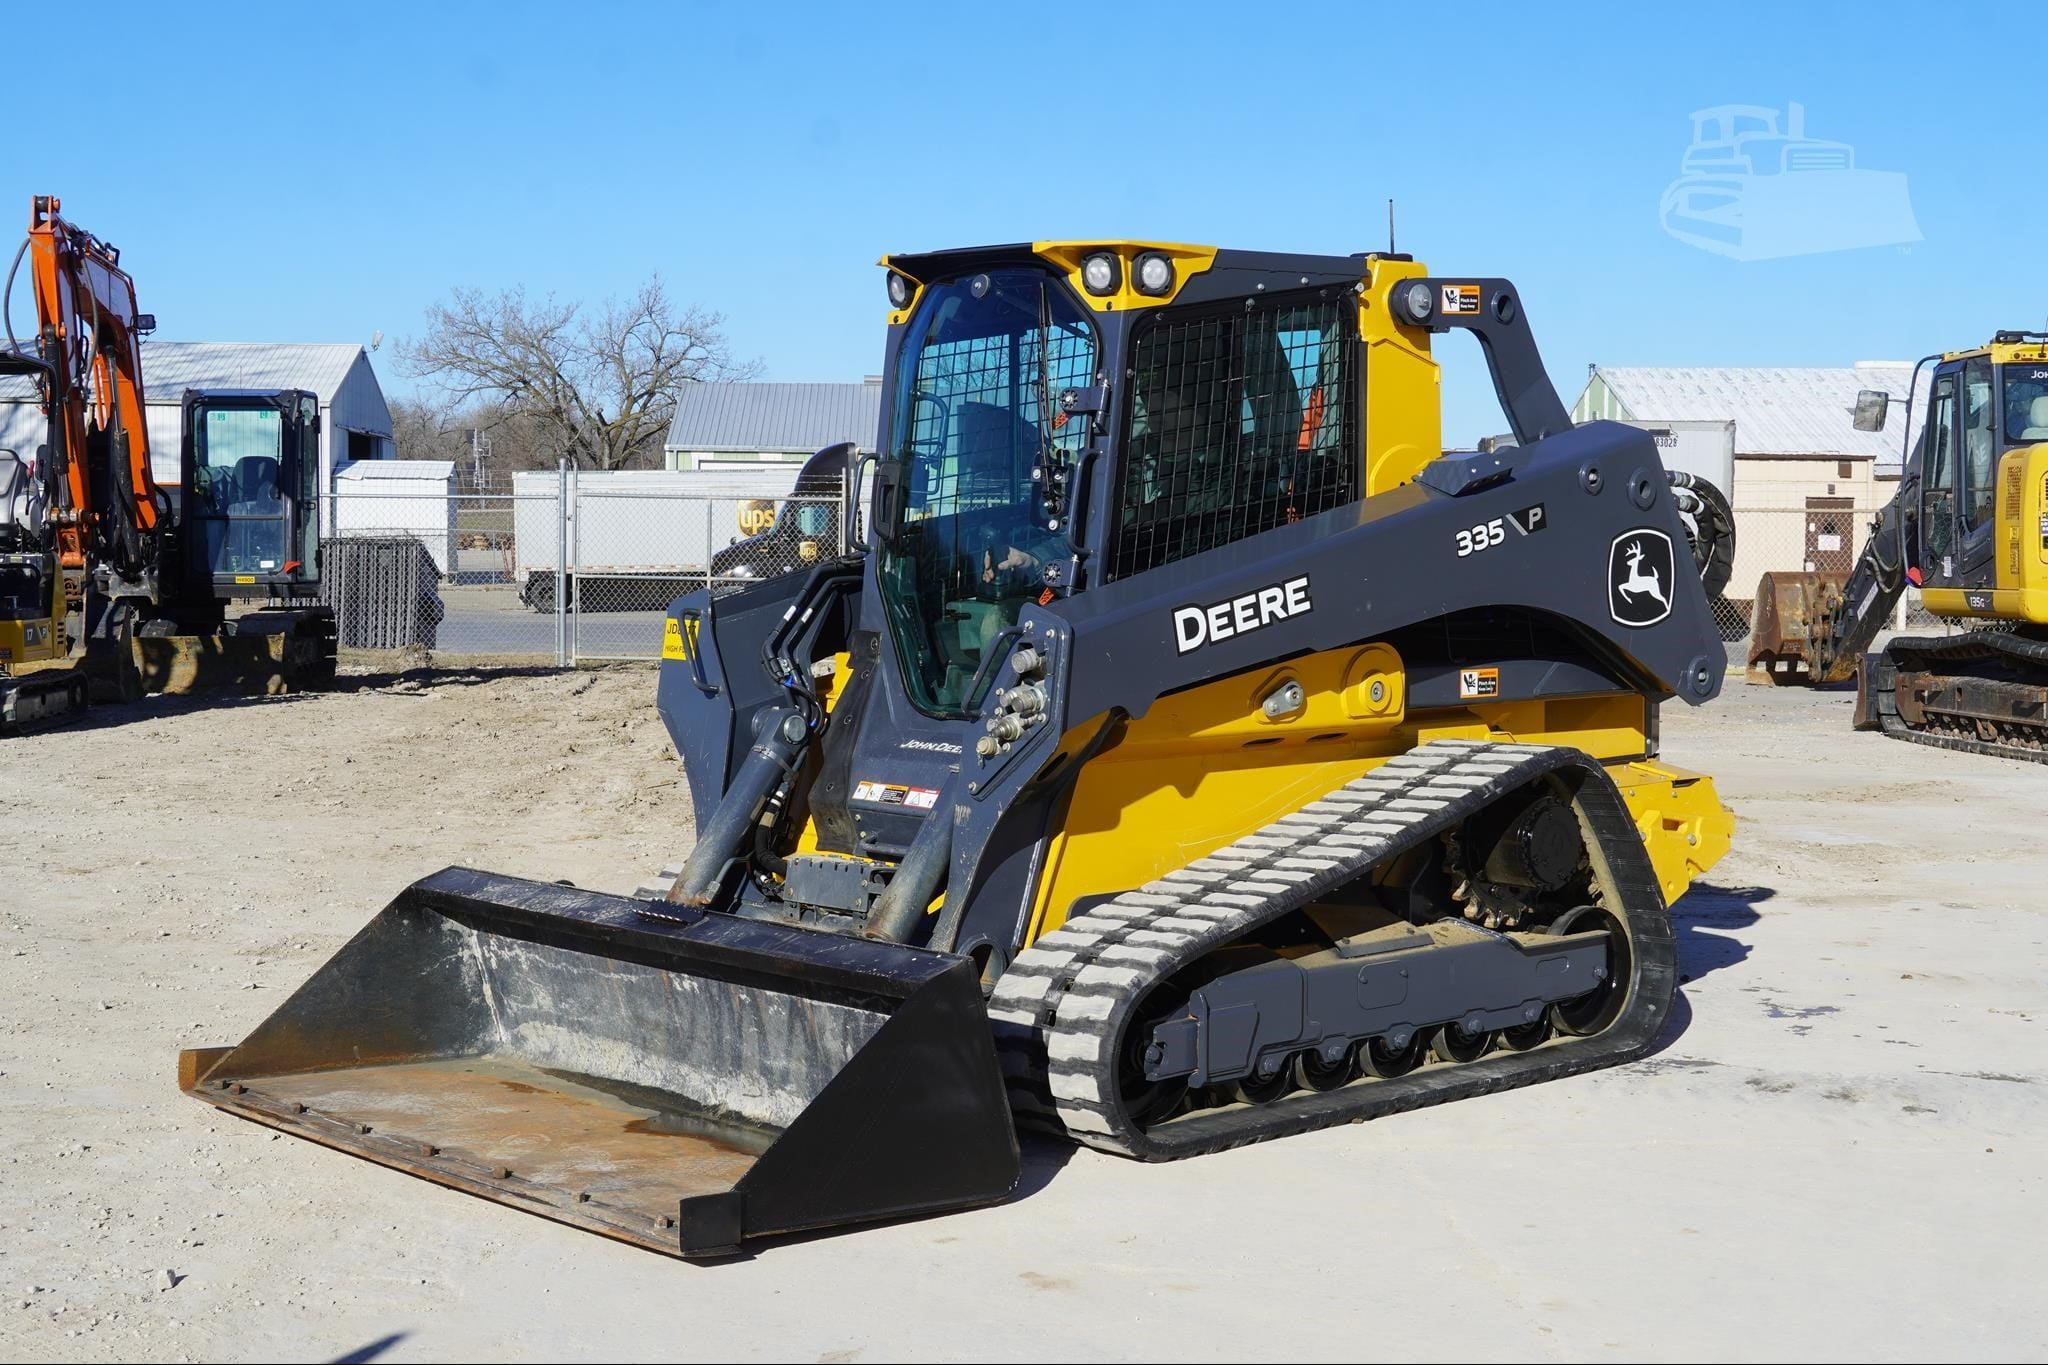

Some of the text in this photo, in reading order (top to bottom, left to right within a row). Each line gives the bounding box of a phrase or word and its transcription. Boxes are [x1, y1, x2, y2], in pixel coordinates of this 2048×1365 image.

[1455, 518, 1505, 557] 335
[1174, 577, 1311, 653] DEERE
[900, 739, 938, 751] JOHN
